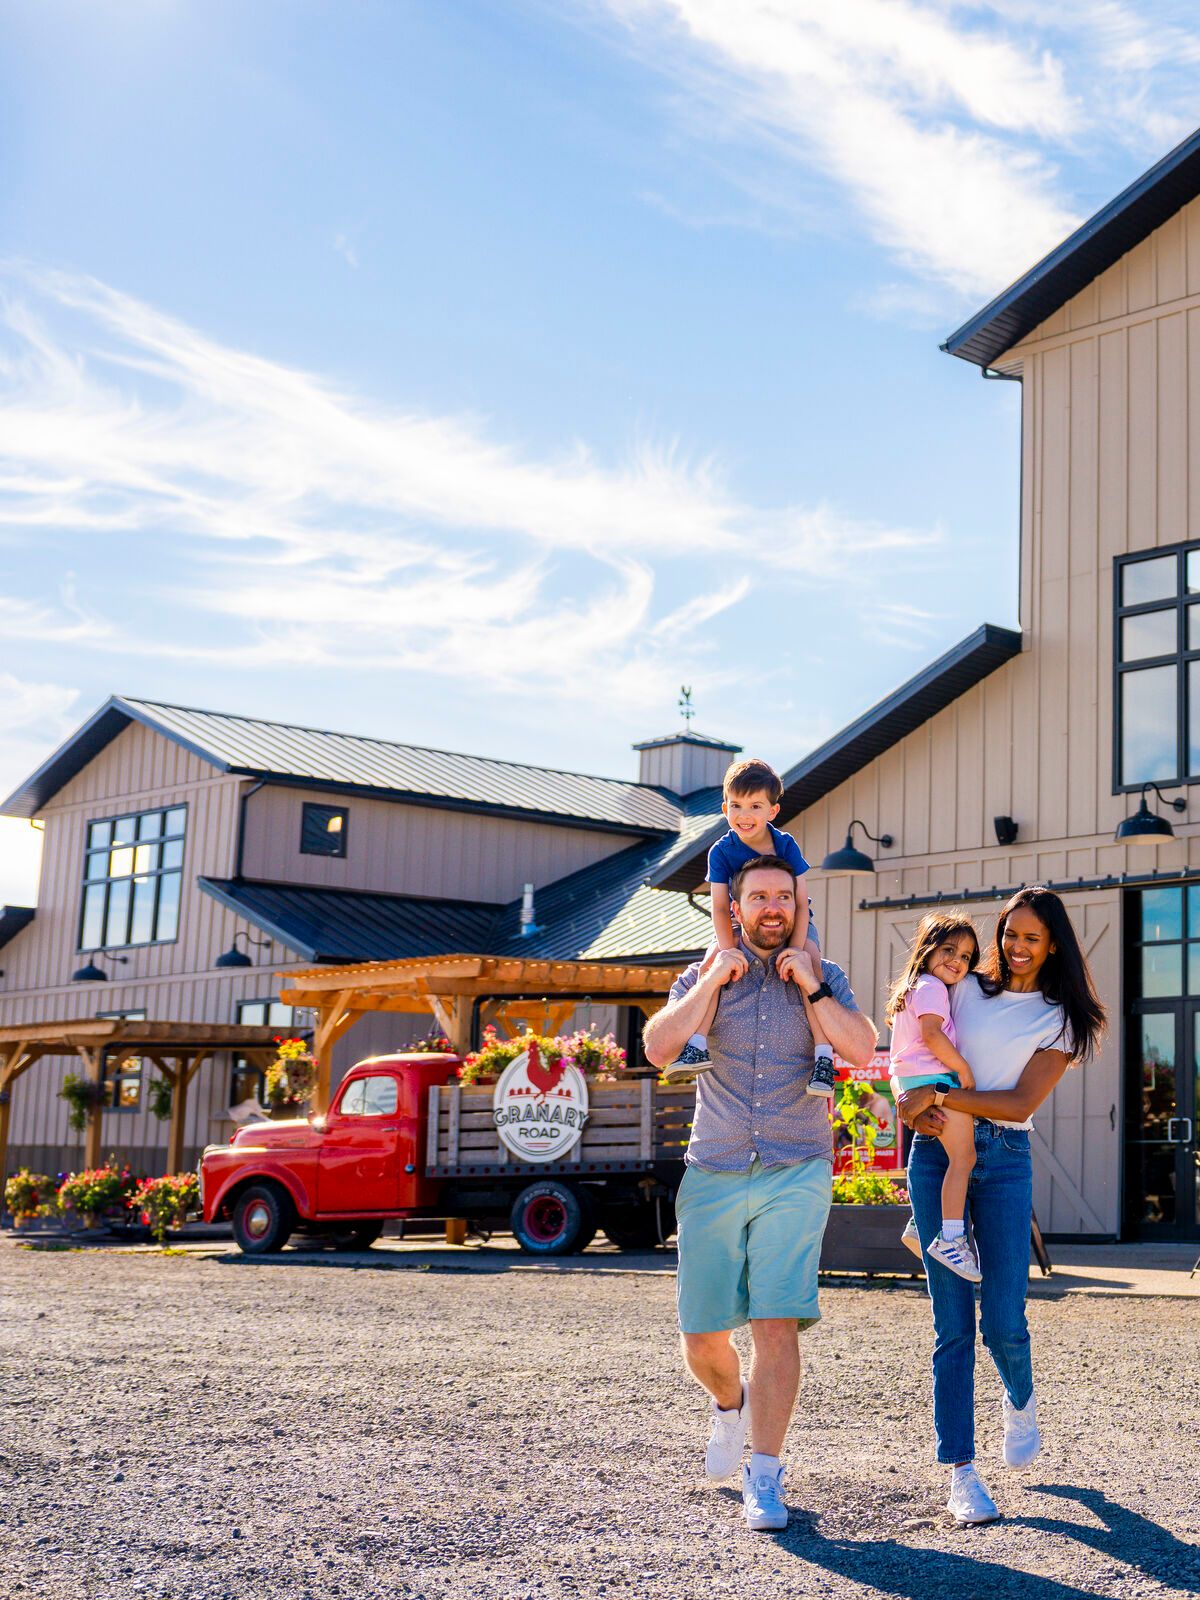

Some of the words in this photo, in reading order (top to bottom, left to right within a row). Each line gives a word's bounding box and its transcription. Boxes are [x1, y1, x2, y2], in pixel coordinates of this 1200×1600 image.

[849, 1069, 882, 1080] YOGA
[493, 1103, 590, 1131] GRANARY
[519, 1127, 560, 1138] ROAD
